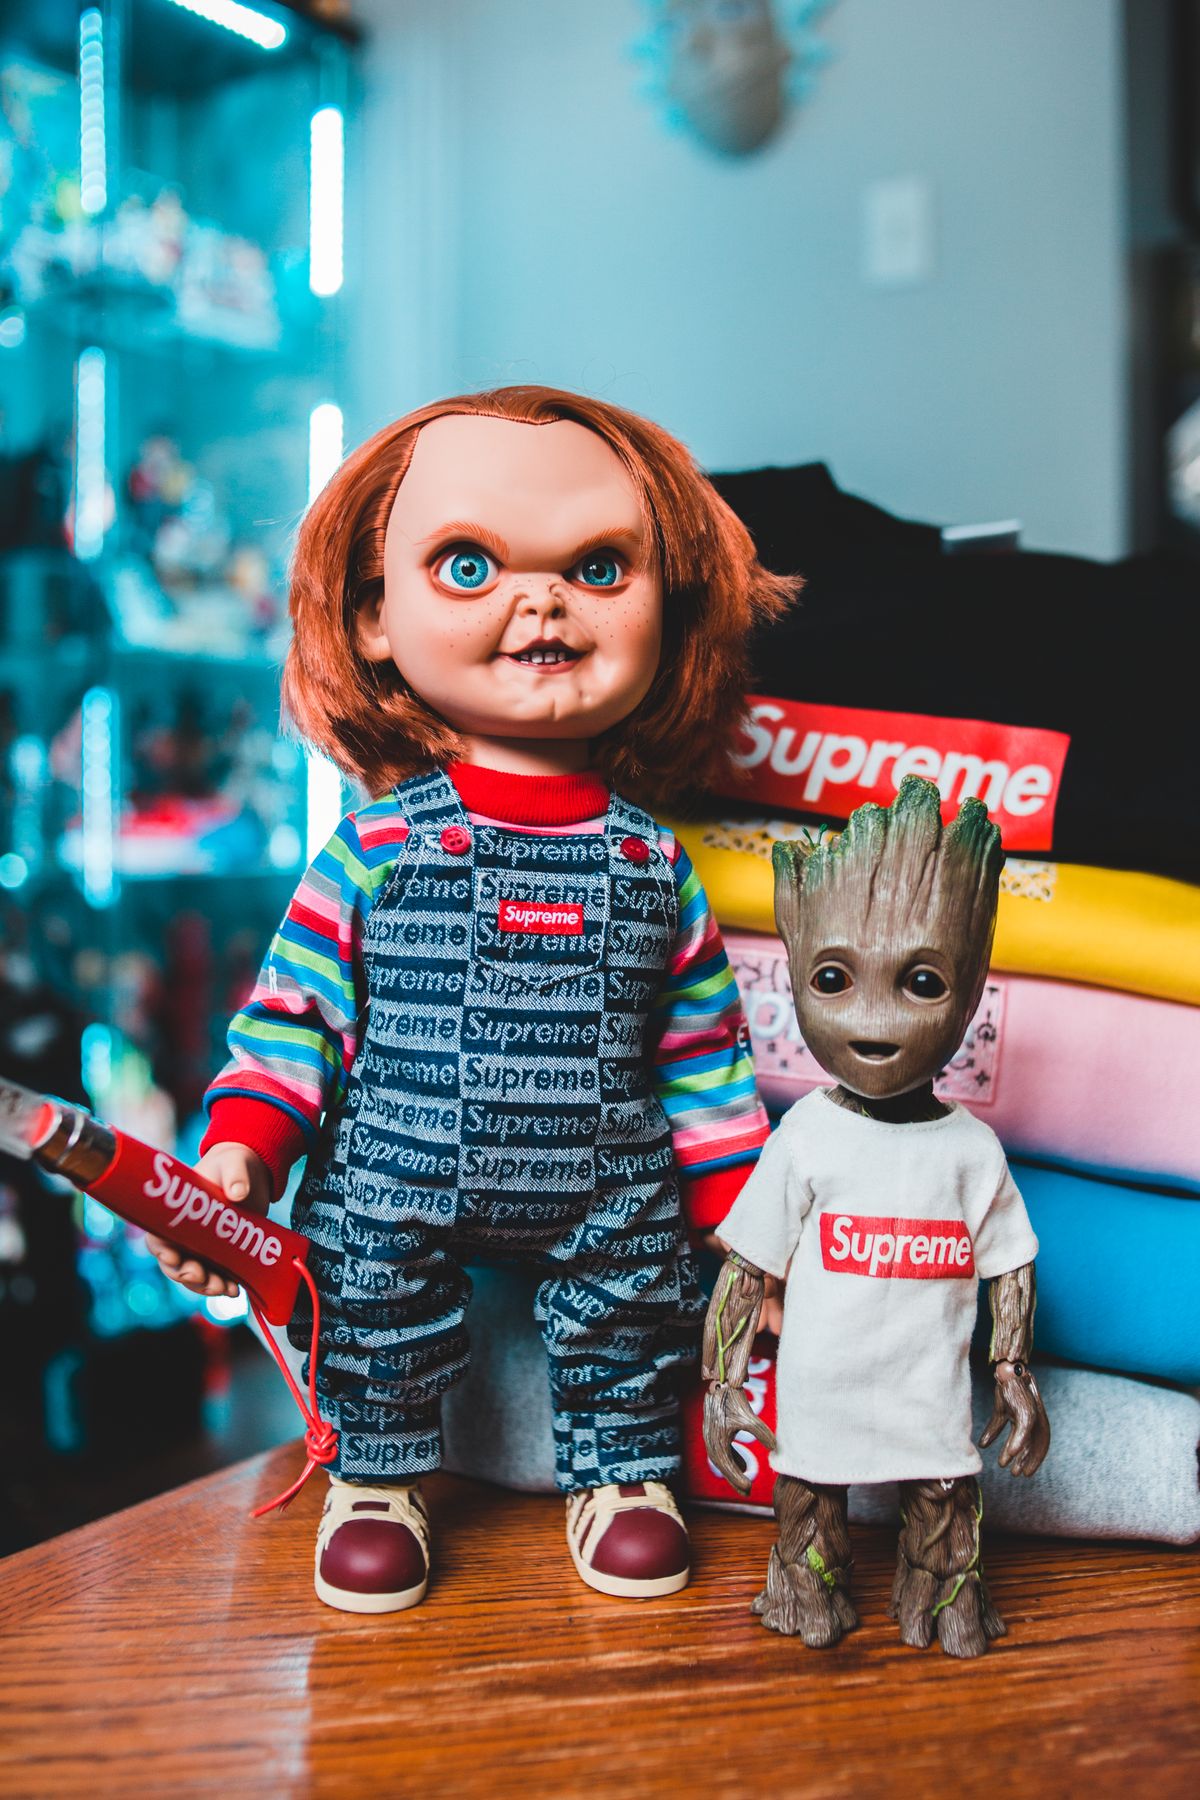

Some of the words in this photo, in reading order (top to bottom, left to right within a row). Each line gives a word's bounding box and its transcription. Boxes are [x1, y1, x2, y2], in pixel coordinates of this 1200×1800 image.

[739, 704, 1053, 817] Supreme
[478, 827, 605, 866] Supreme
[504, 905, 579, 928] Supreme
[476, 918, 602, 959] Supreme
[372, 1010, 457, 1039] preme
[464, 1010, 598, 1051] Supreme
[463, 1057, 595, 1098] Supreme
[463, 1104, 598, 1143] Supreme
[351, 1126, 457, 1176] Supreme
[462, 1150, 593, 1187] Supreme
[143, 1152, 283, 1266] Supreme
[346, 1171, 454, 1215] Supreme
[459, 1193, 587, 1225] Supreme
[829, 1216, 972, 1276] Supreme
